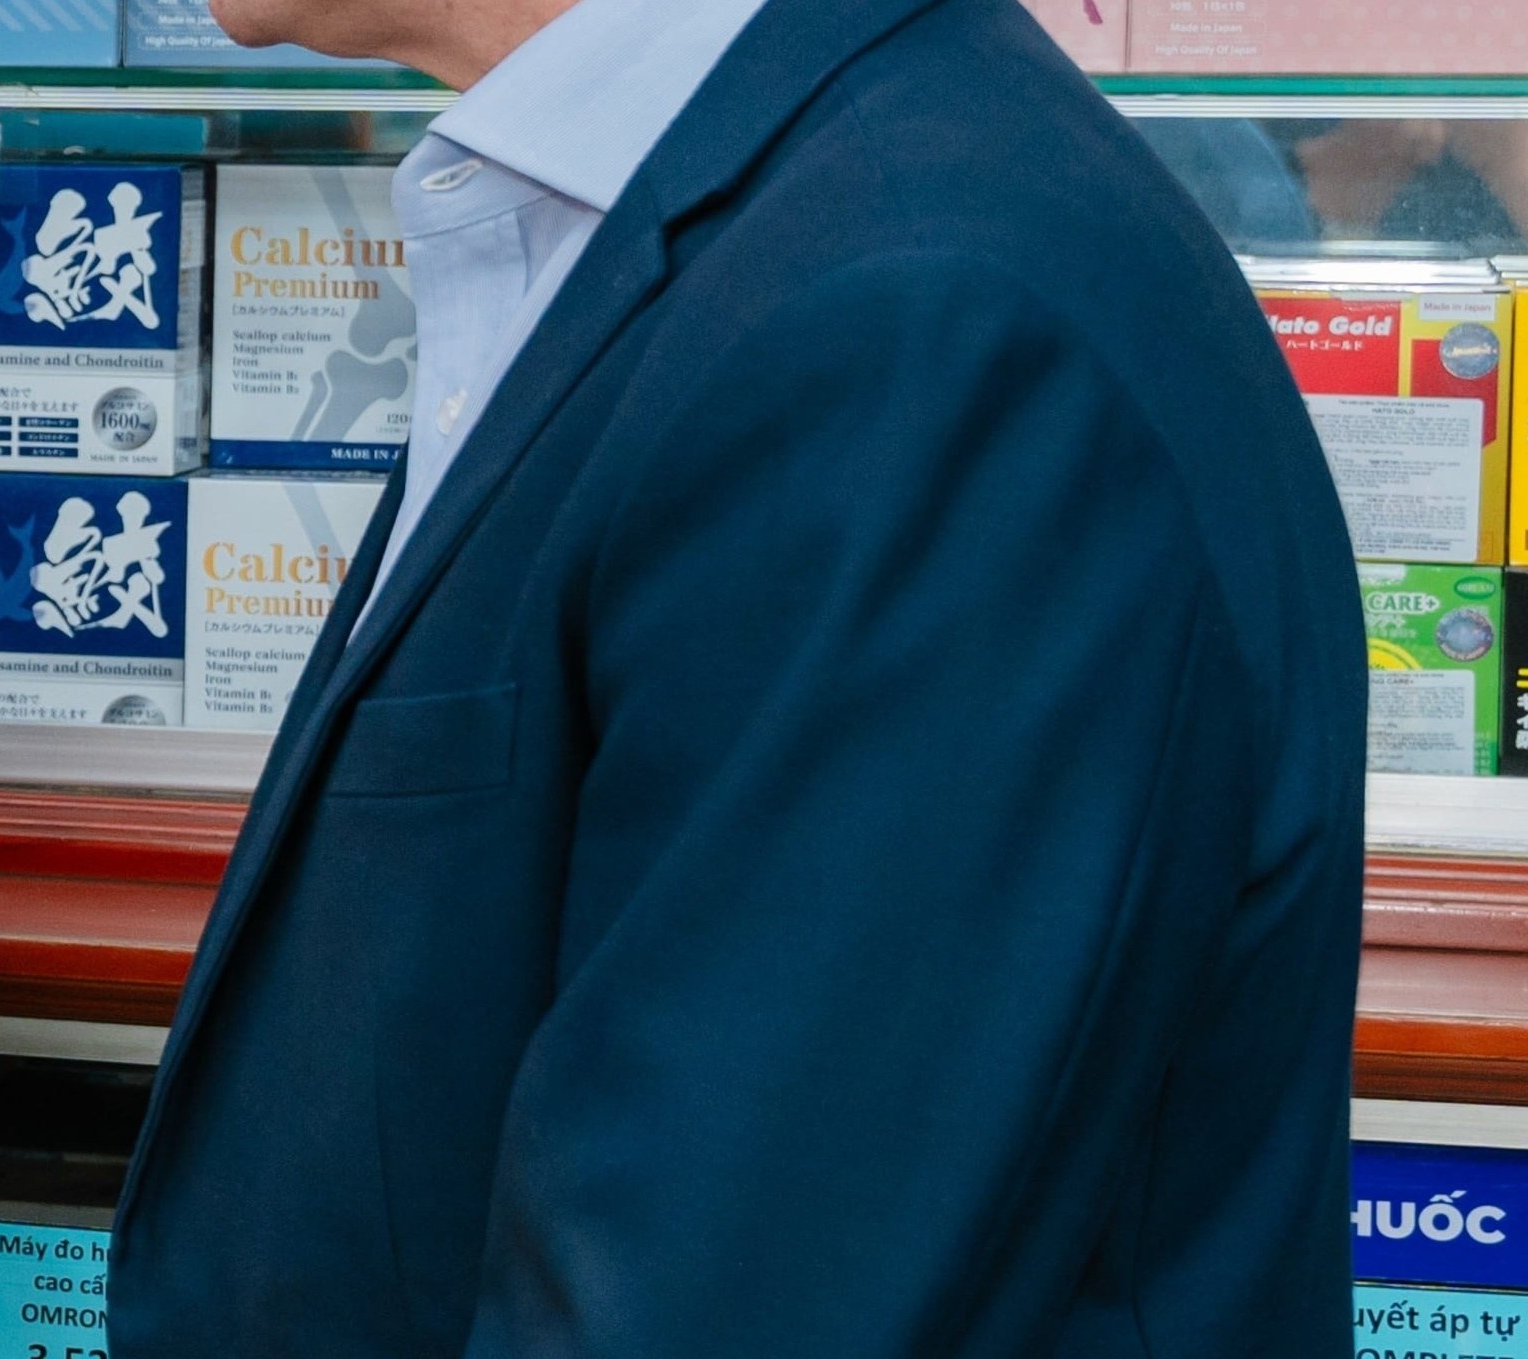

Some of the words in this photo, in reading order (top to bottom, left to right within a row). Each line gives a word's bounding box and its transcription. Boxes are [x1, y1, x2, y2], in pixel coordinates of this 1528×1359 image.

[232, 270, 381, 300] Premium
[232, 329, 279, 342] Scallop
[281, 330, 332, 342] calcium
[1329, 314, 1393, 338] Gold
[46, 352, 71, 368] and
[74, 353, 164, 370] Chondroitin
[232, 343, 304, 356] Magnesium
[232, 357, 259, 367] Iron
[232, 370, 282, 381] Vitamin
[1350, 1189, 1507, 1245] HUỐC
[53, 1238, 85, 1262] đo
[33, 1273, 75, 1294] cao
[79, 1268, 107, 1296] cấ
[1351, 1299, 1420, 1335] uyết
[1429, 1304, 1470, 1338] áp
[1480, 1308, 1521, 1341] tự
